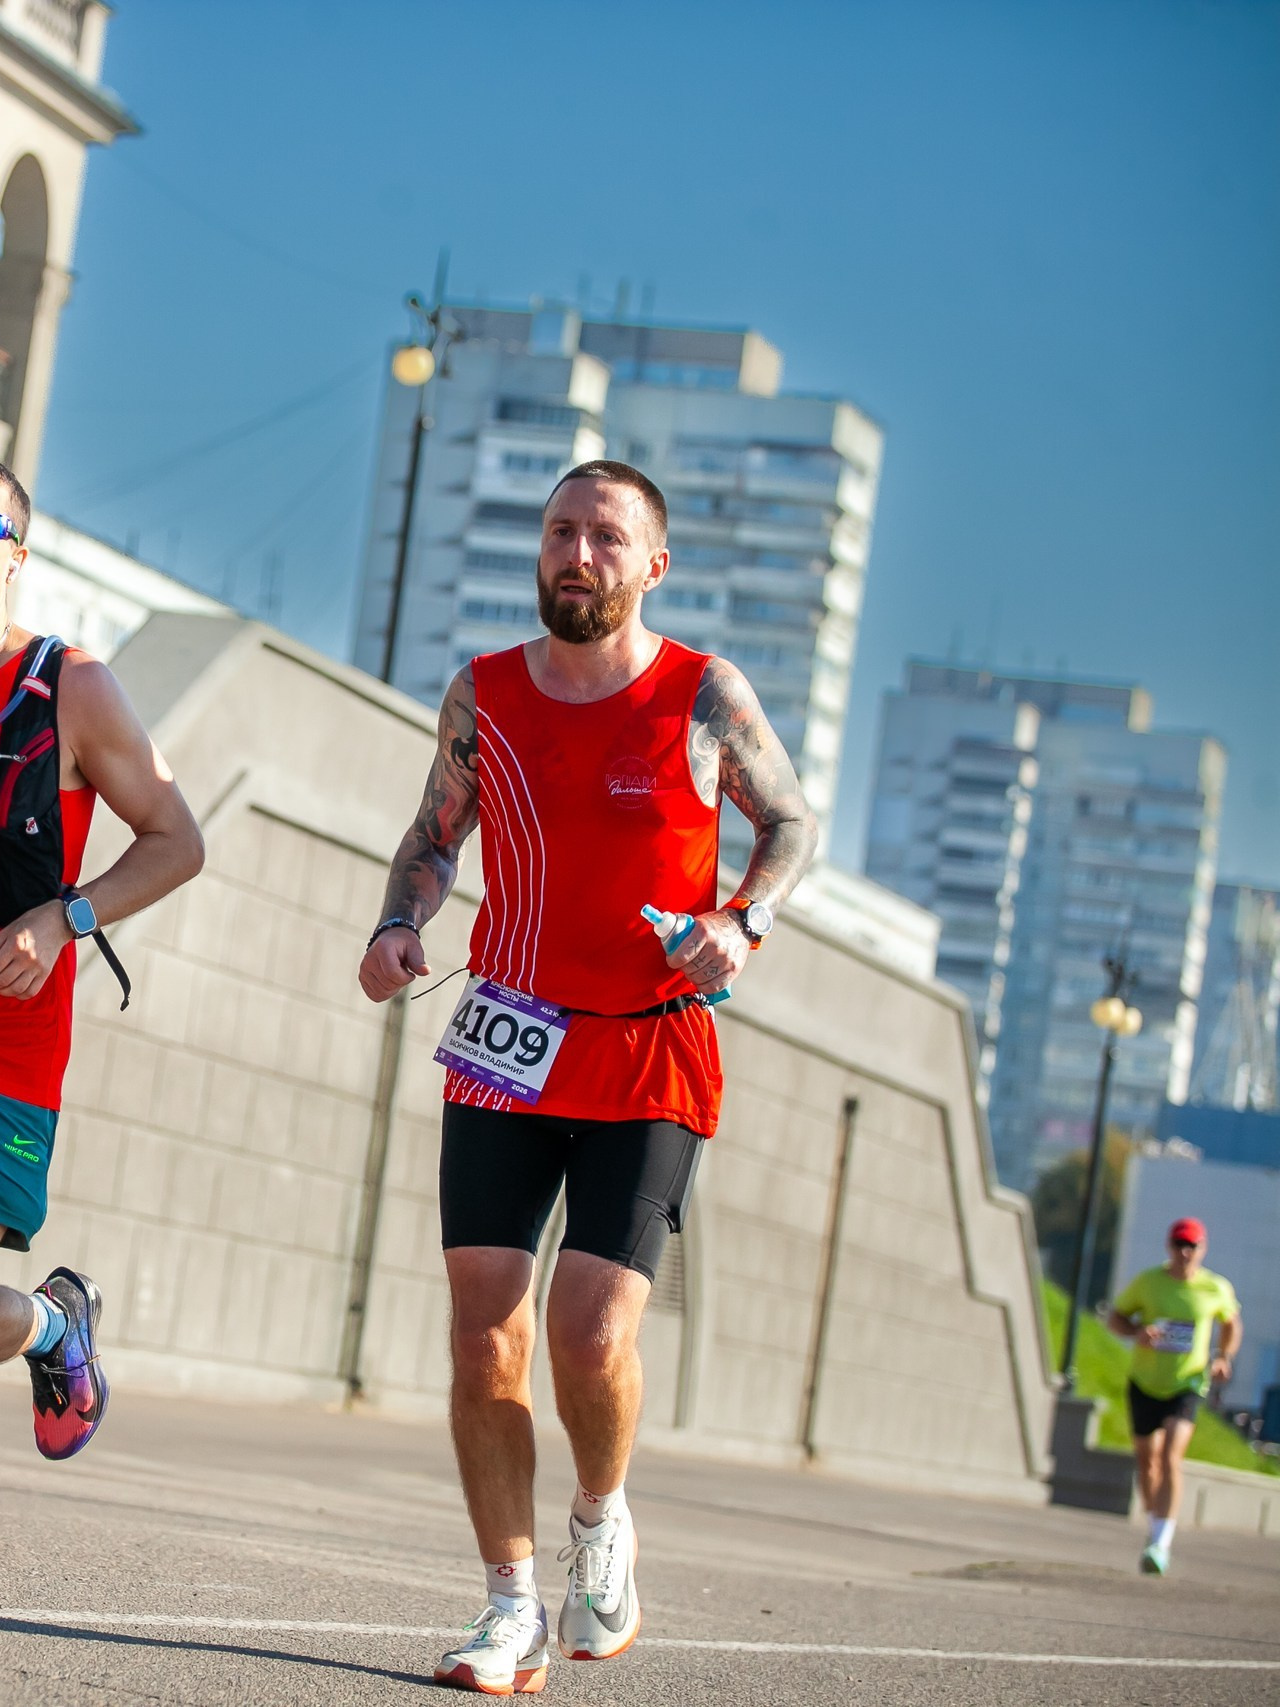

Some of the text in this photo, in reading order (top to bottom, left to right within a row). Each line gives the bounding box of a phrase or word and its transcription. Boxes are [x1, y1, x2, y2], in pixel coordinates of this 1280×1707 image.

[490, 981, 534, 1003] КРАСНОЯРСКИЕ
[499, 990, 520, 1003] МОСТЫ
[540, 1006, 553, 1016] 42,2
[451, 998, 549, 1067] 4109
[479, 1051, 525, 1075] ВЛАДИМИР
[511, 1083, 528, 1095] 2026
[5, 1143, 39, 1162] NIKE PRO
